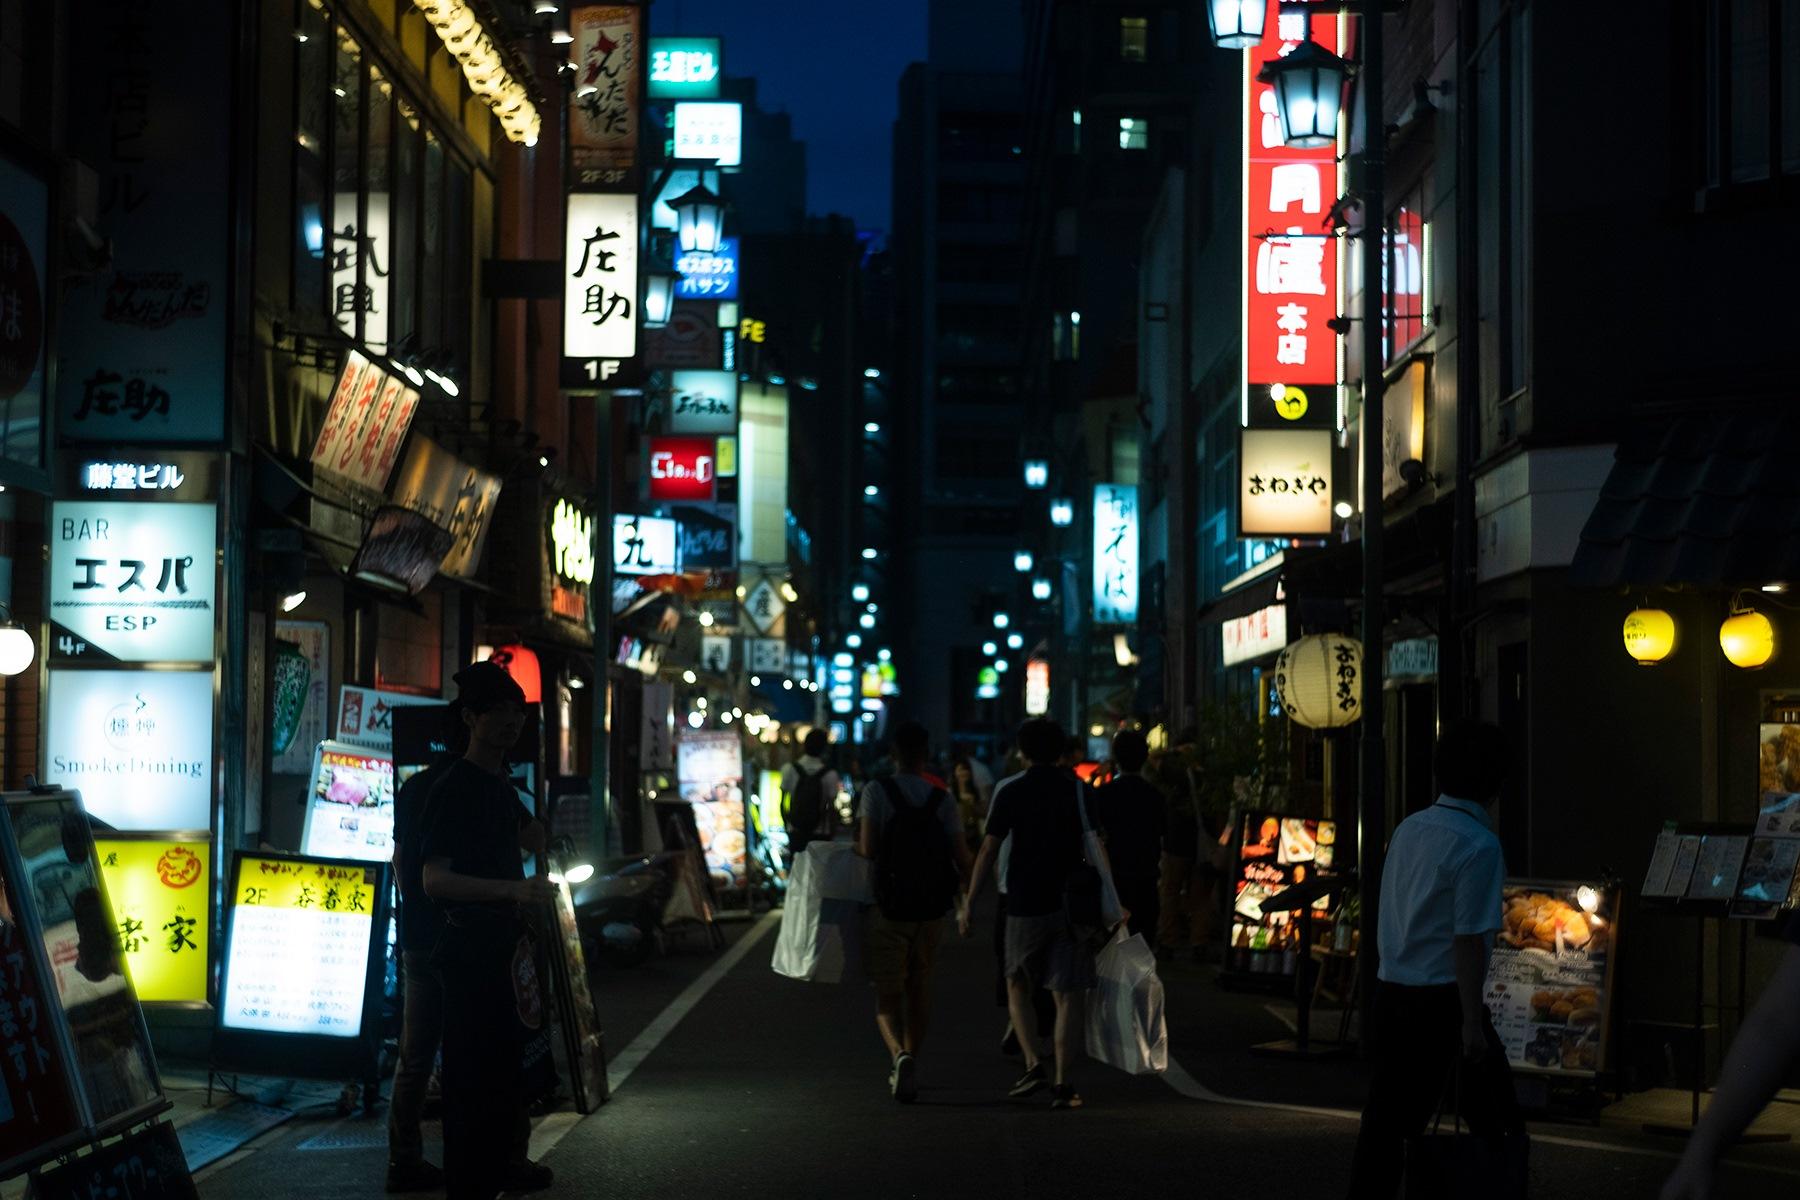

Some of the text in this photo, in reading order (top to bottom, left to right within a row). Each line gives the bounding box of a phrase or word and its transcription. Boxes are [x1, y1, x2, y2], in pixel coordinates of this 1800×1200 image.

[572, 225, 630, 326] 庄助
[584, 360, 621, 381] 1F
[74, 369, 171, 421] 庄助
[87, 462, 185, 489] 藤堂ビル
[62, 518, 110, 541] BAR
[72, 556, 194, 594] エスパ
[105, 615, 158, 631] ESP
[59, 635, 86, 656] 4F
[244, 887, 269, 904] 2F
